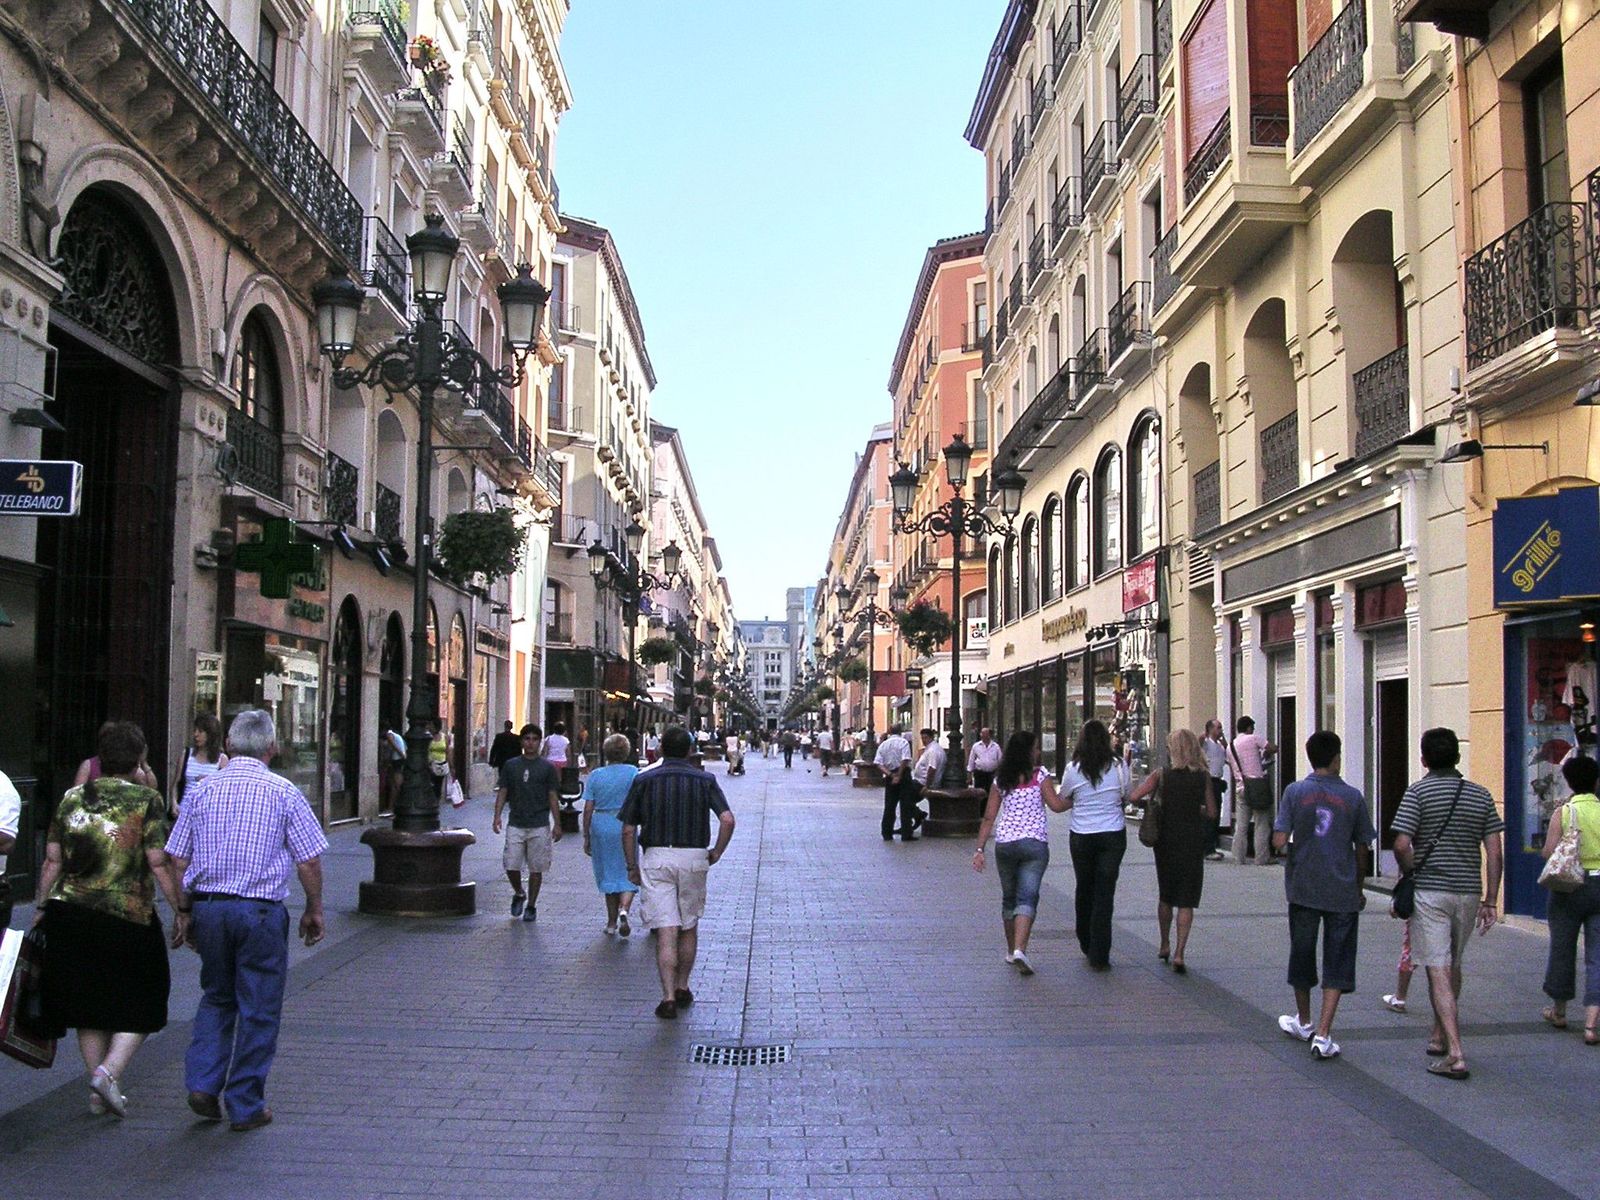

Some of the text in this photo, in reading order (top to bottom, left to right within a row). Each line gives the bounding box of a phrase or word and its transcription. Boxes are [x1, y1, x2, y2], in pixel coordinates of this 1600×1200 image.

[0, 494, 64, 510] TELEBANCO
[961, 673, 988, 685] FLA
[1314, 806, 1335, 837] 3
